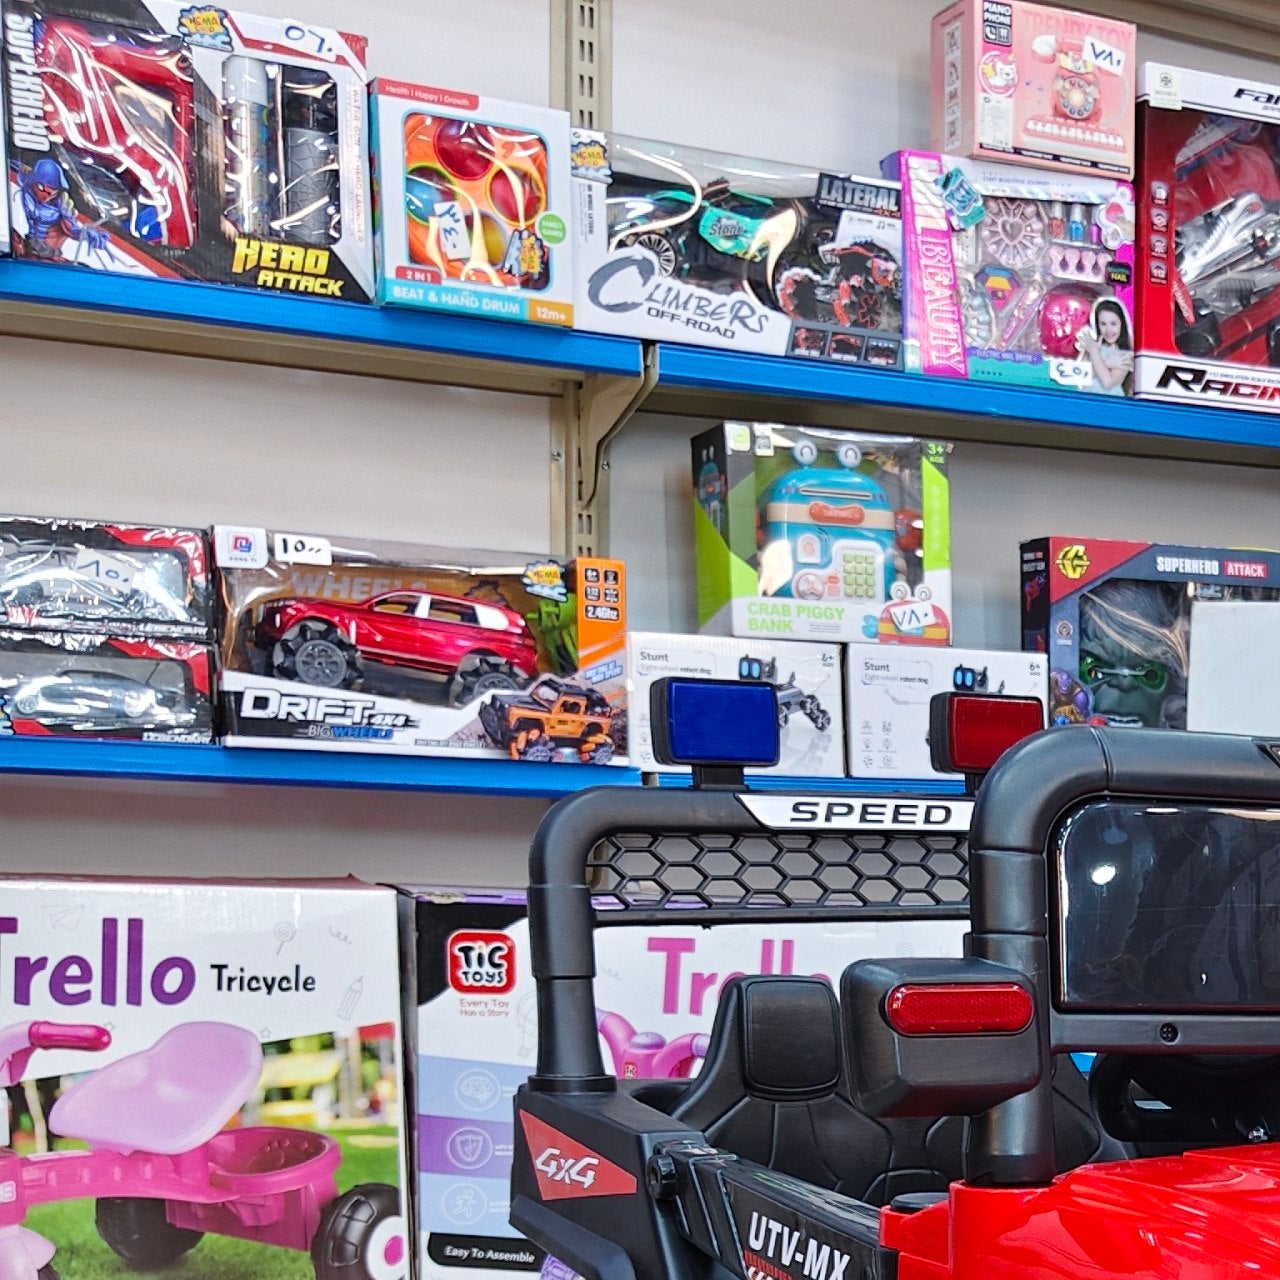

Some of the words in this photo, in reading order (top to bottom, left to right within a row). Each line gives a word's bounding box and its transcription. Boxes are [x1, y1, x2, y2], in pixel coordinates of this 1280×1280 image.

[819, 177, 900, 212] LATERAL
[231, 237, 330, 275] HERO
[257, 269, 344, 297] ATTACK
[393, 286, 423, 301] BEAT
[427, 290, 439, 302] &
[441, 292, 480, 309] HAND
[482, 297, 521, 315] DRUM
[646, 305, 737, 340] OFF-ROAD
[1155, 555, 1220, 576] SUPERHERO
[1226, 562, 1266, 577] ATTACK
[747, 602, 793, 618] CRAB
[796, 605, 845, 620] PIGGY
[747, 618, 795, 634] BANK
[640, 651, 670, 663] Stunt
[864, 661, 891, 673] Stunt
[239, 687, 376, 726] DRIFT
[307, 724, 331, 738] BIG
[331, 725, 394, 741] WHEELS
[789, 801, 952, 826] SPEED
[210, 963, 316, 994] Tricycle
[461, 970, 505, 985] TOYS
[459, 1008, 478, 1018] Has
[486, 1008, 510, 1018] Story
[460, 998, 489, 1009] Every
[491, 998, 510, 1008] Toy
[444, 1244, 470, 1260] Easy
[471, 1248, 486, 1259] To
[486, 1248, 536, 1264] Assemble
